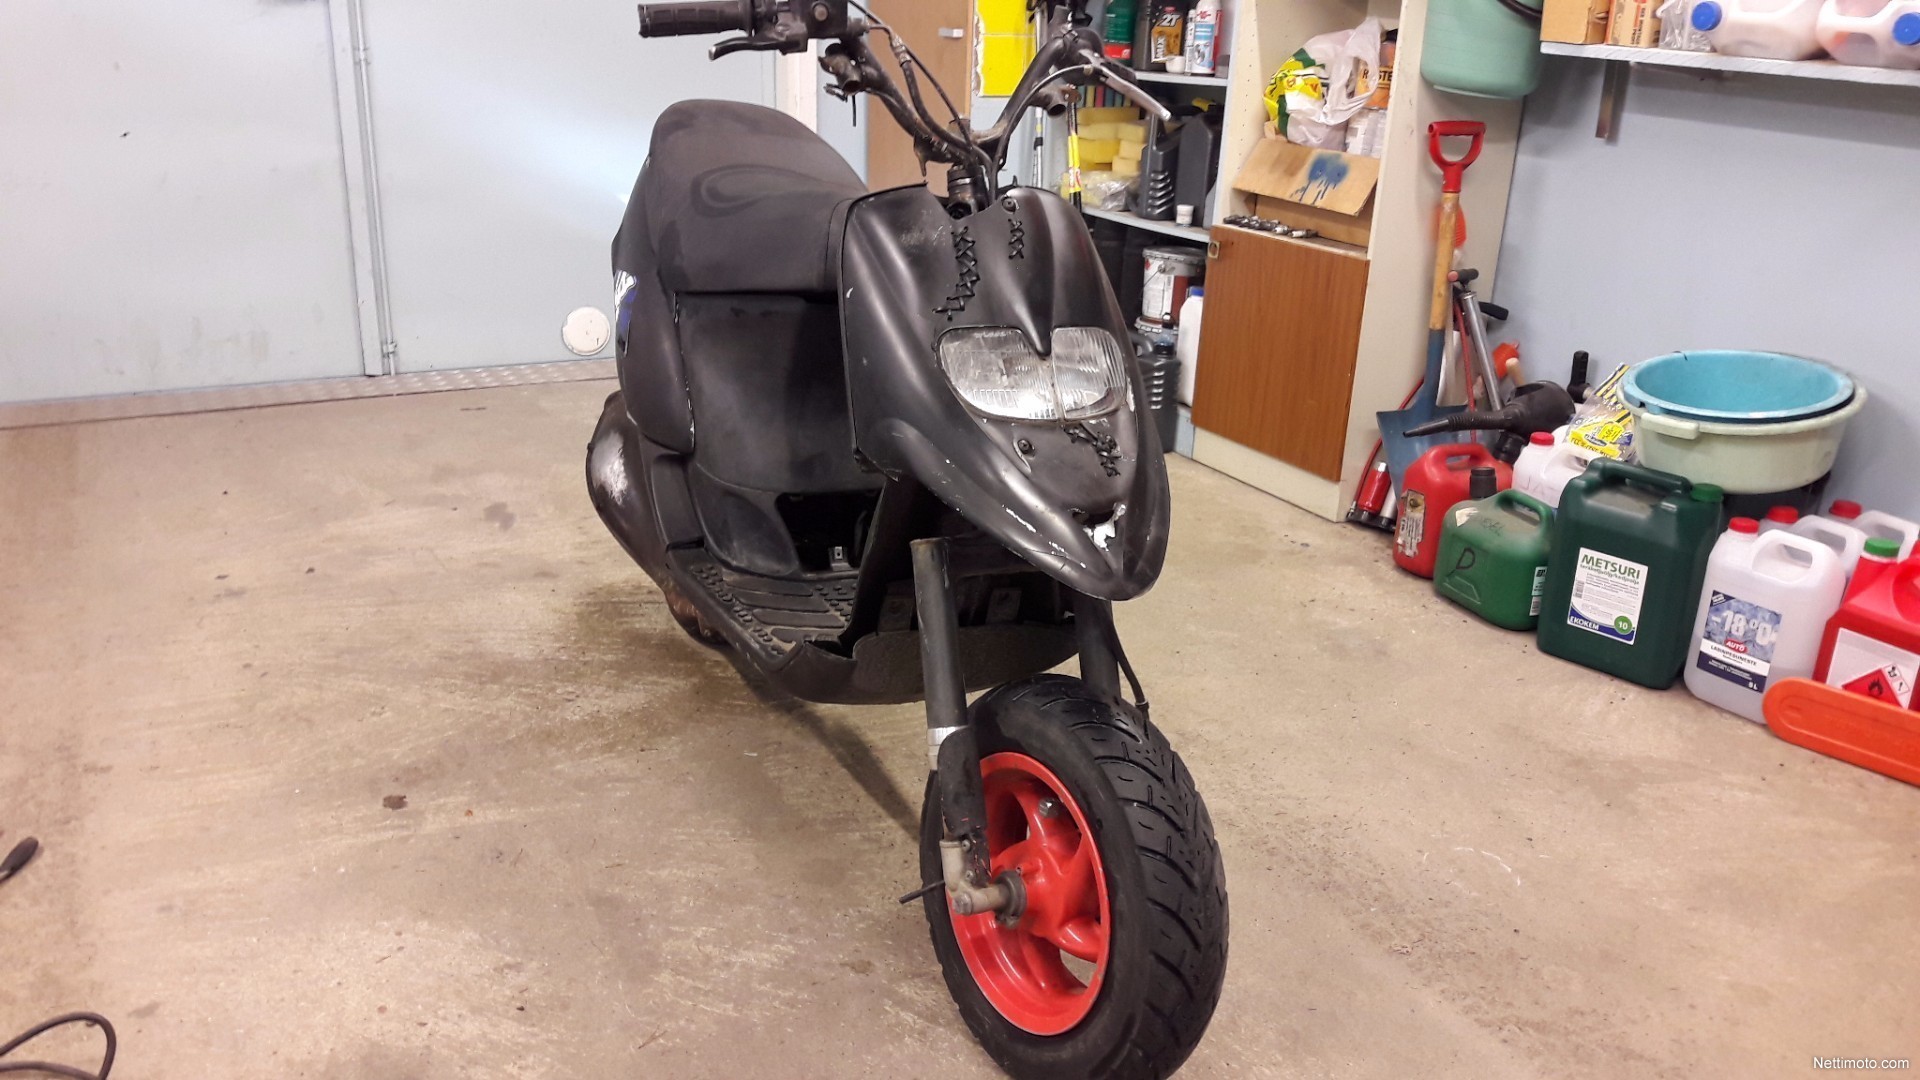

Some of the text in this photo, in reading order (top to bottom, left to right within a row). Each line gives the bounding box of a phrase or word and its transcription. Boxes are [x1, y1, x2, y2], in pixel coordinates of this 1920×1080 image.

[1160, 14, 1181, 27] 2T
[1581, 554, 1641, 579] METSURI
[1570, 615, 1600, 631] EKOKEM
[1618, 620, 1628, 630] 10
[1725, 640, 1745, 652] AUTO
